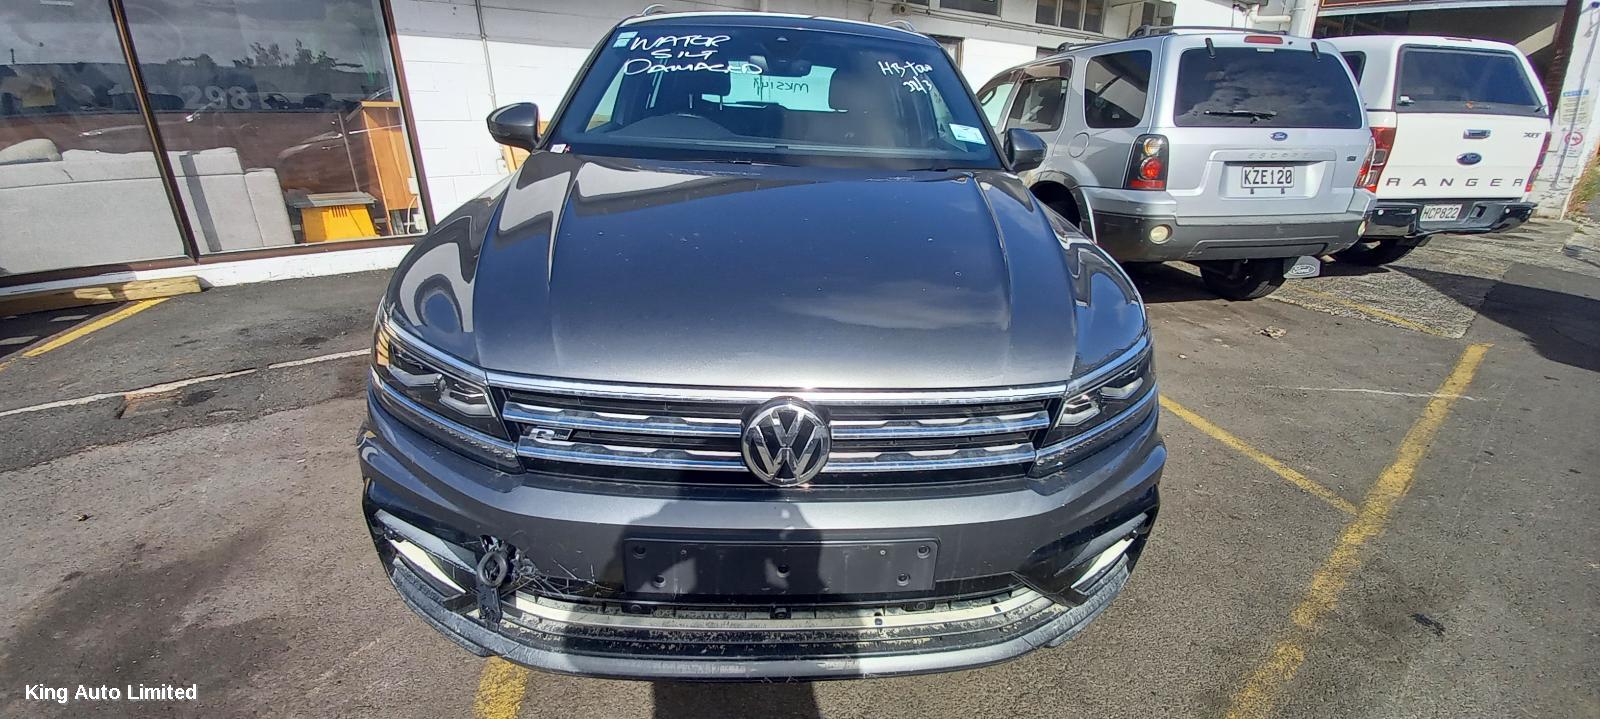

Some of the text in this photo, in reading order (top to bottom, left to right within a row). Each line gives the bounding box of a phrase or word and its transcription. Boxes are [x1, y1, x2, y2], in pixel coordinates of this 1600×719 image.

[650, 48, 719, 60] SILT
[1244, 169, 1293, 185] KZE120
[1385, 178, 1524, 187] RANGER
[1421, 206, 1460, 220] HCP822
